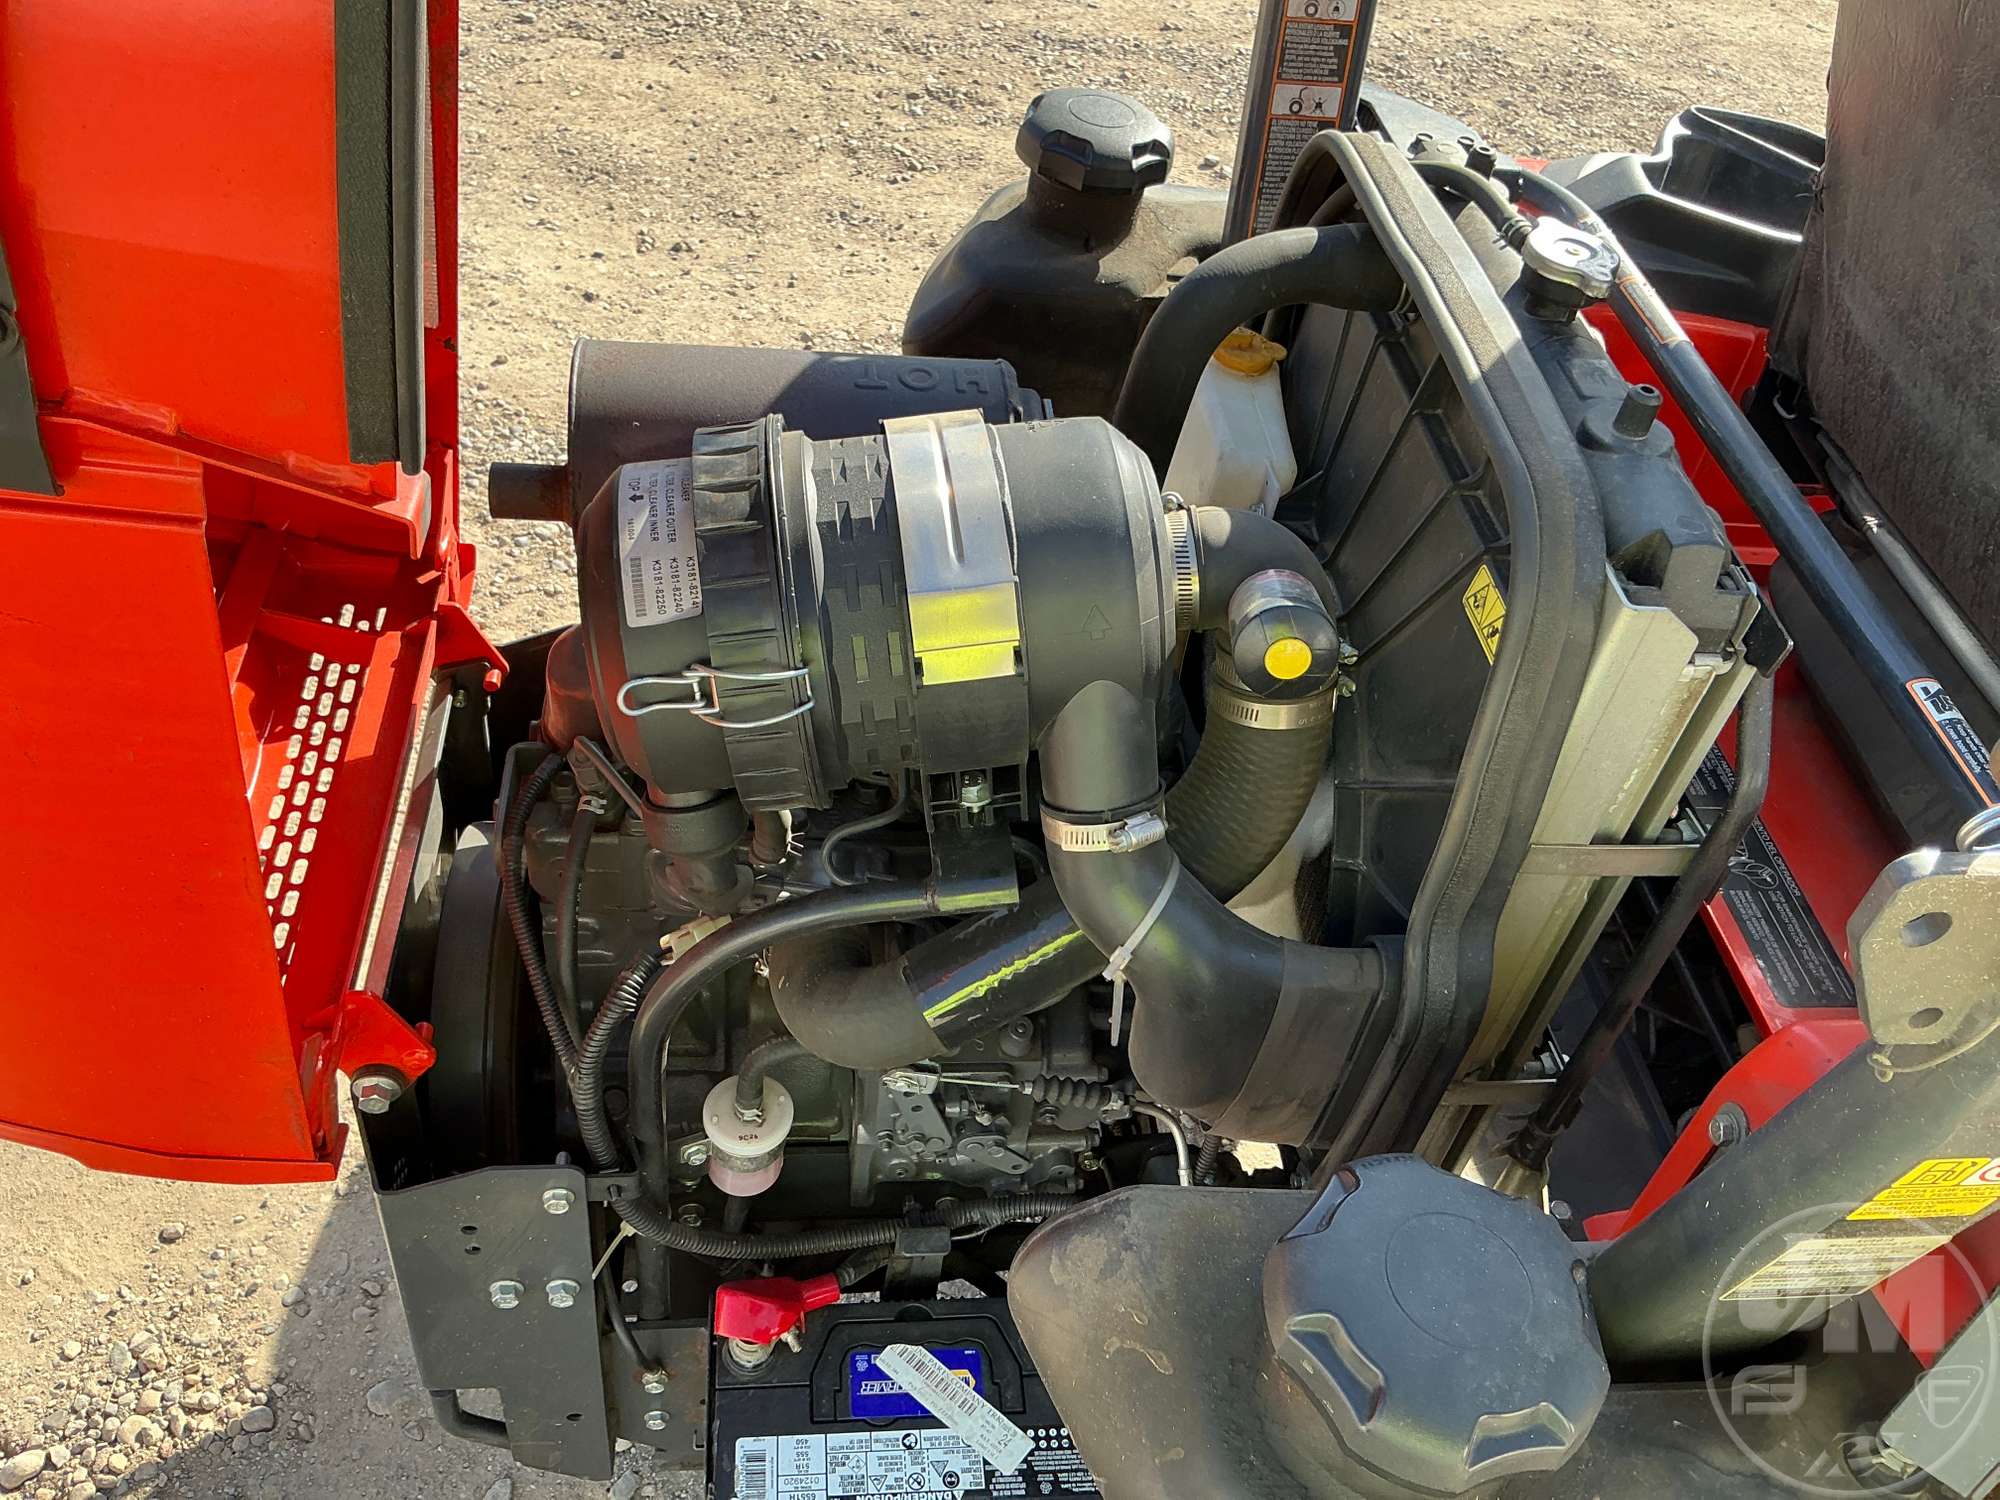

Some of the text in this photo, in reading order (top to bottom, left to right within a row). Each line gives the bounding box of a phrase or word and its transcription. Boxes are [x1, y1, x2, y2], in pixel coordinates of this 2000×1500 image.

[854, 360, 989, 395] HOT
[628, 477, 640, 491] TOP
[665, 489, 674, 516] CLEANER
[649, 519, 658, 542] INNER
[666, 518, 676, 543] OUTER
[669, 557, 683, 613] K3181-82240
[686, 555, 699, 608] K3181-82141
[783, 1476, 819, 1485] 0124920
